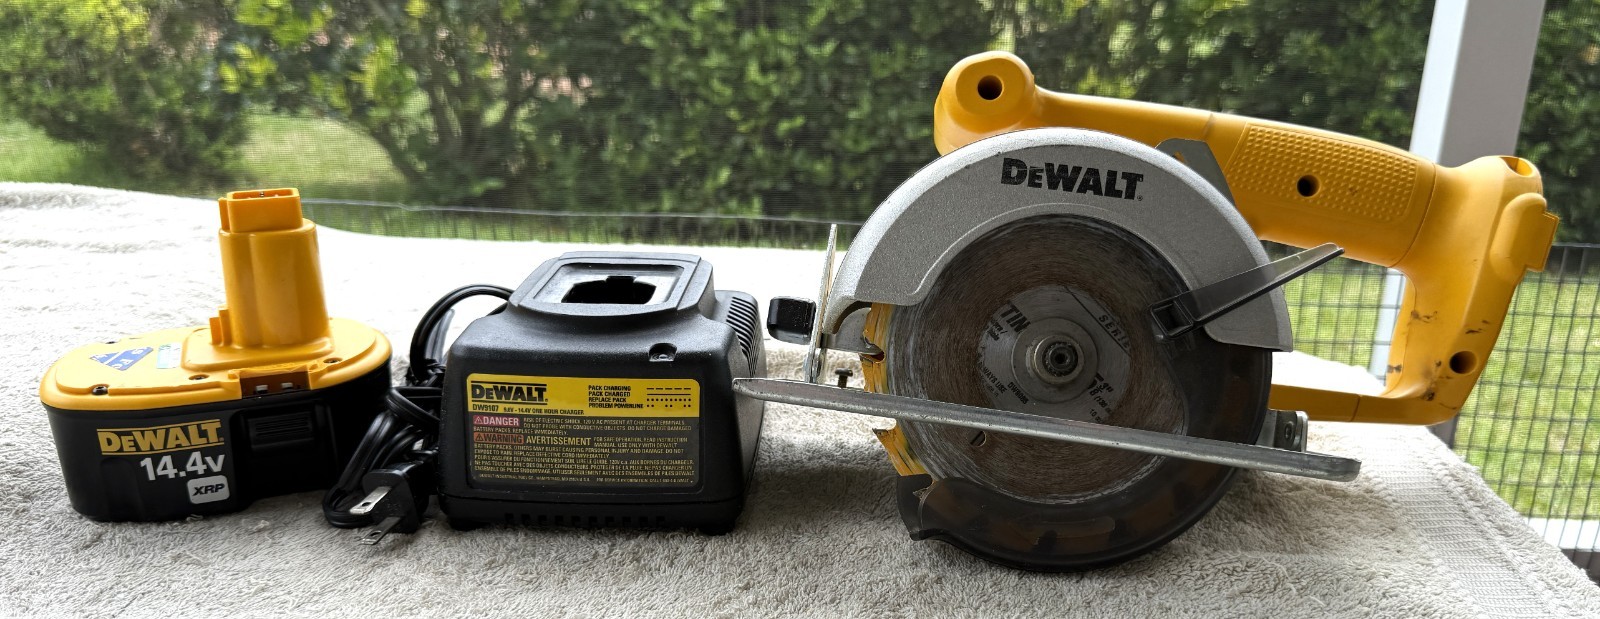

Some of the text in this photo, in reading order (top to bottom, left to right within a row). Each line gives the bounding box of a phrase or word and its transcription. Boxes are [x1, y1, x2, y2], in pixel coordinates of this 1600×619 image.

[1001, 158, 1144, 200] DEWALT
[471, 384, 546, 402] DEWALT
[483, 416, 519, 426] DANGER
[97, 421, 222, 452] DEWALT
[484, 434, 591, 445] WARNING AVERTISSEMENT
[193, 484, 225, 496] XRP
